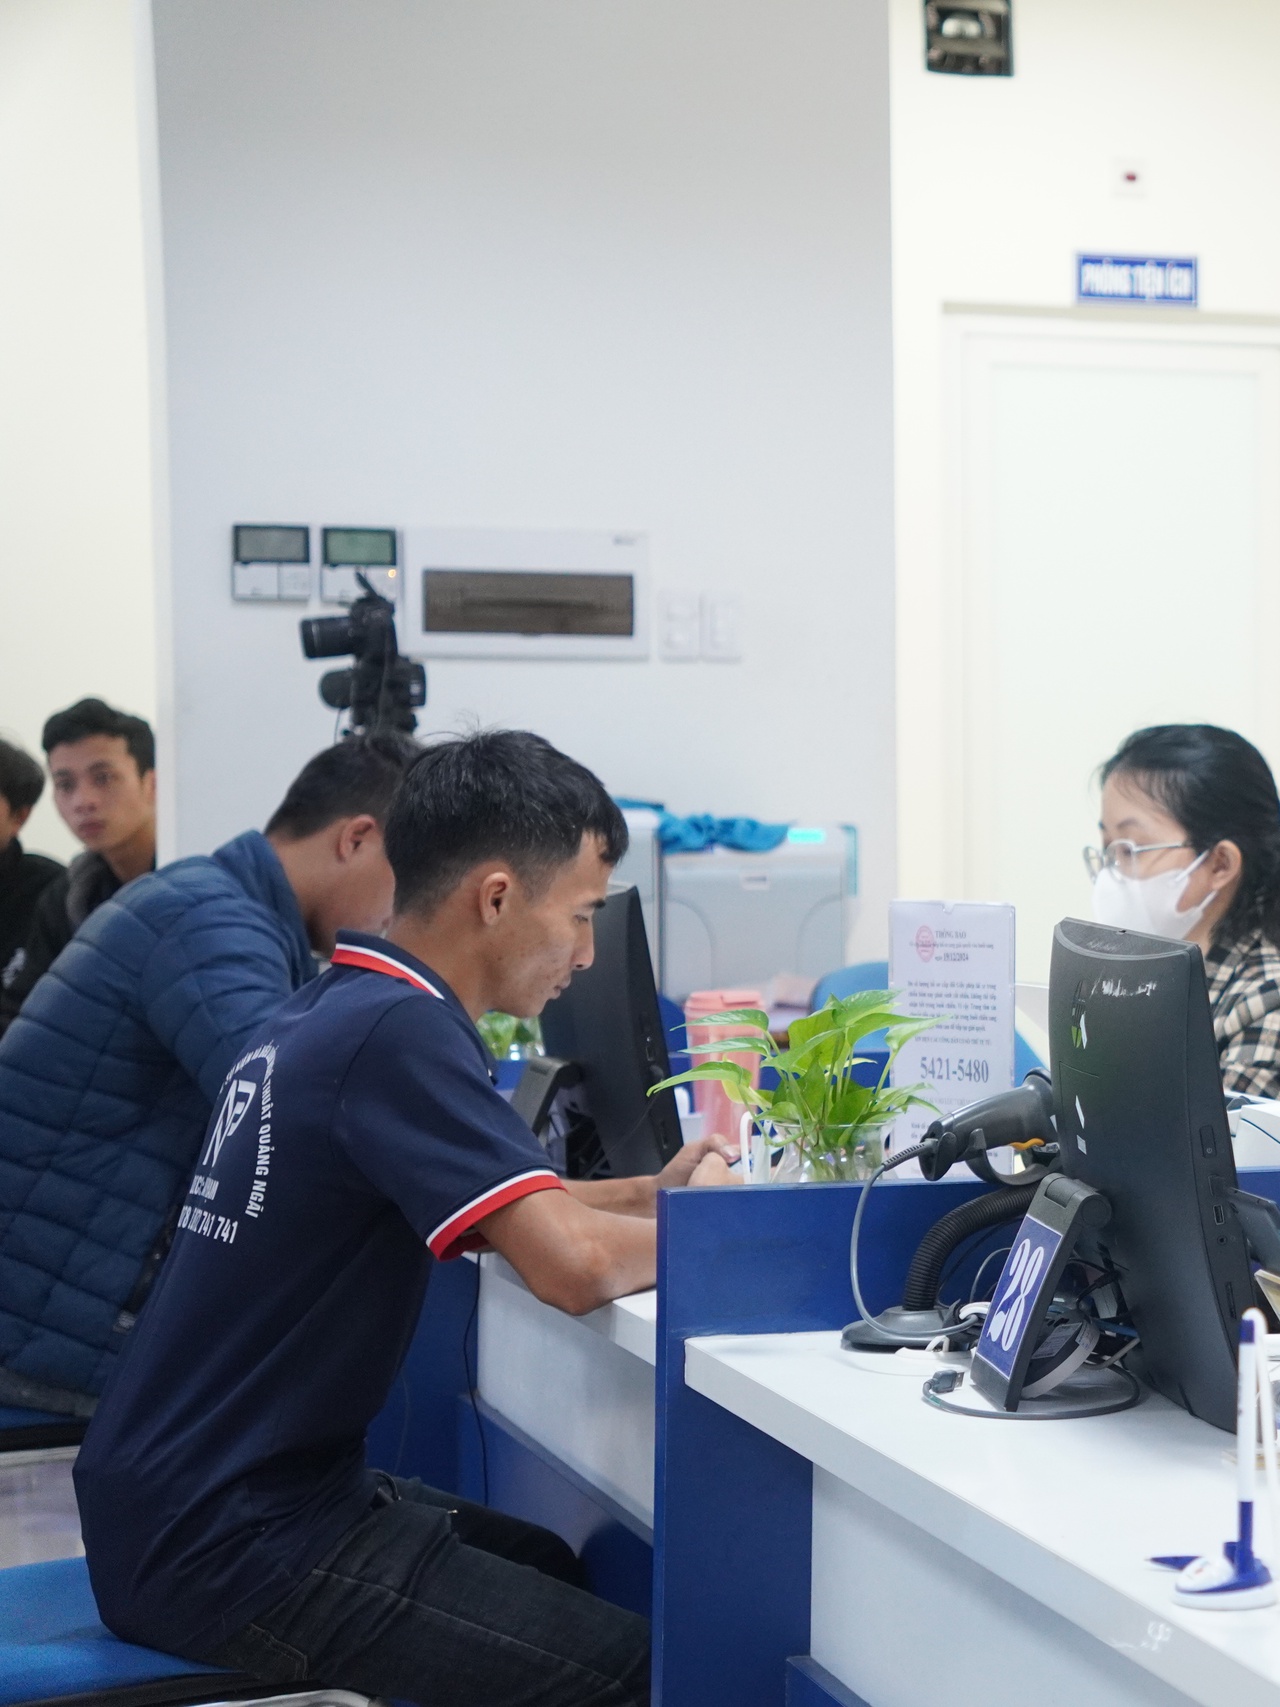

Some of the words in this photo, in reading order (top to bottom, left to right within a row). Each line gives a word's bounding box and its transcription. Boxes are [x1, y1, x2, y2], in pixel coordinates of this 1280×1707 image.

[920, 1056, 989, 1083] 5421-5480
[255, 1124, 275, 1176] QUẢNG
[245, 1180, 267, 1218] NGÃI
[197, 1210, 216, 1237] 741
[213, 1216, 239, 1244] 741
[986, 1238, 1045, 1352] 28
